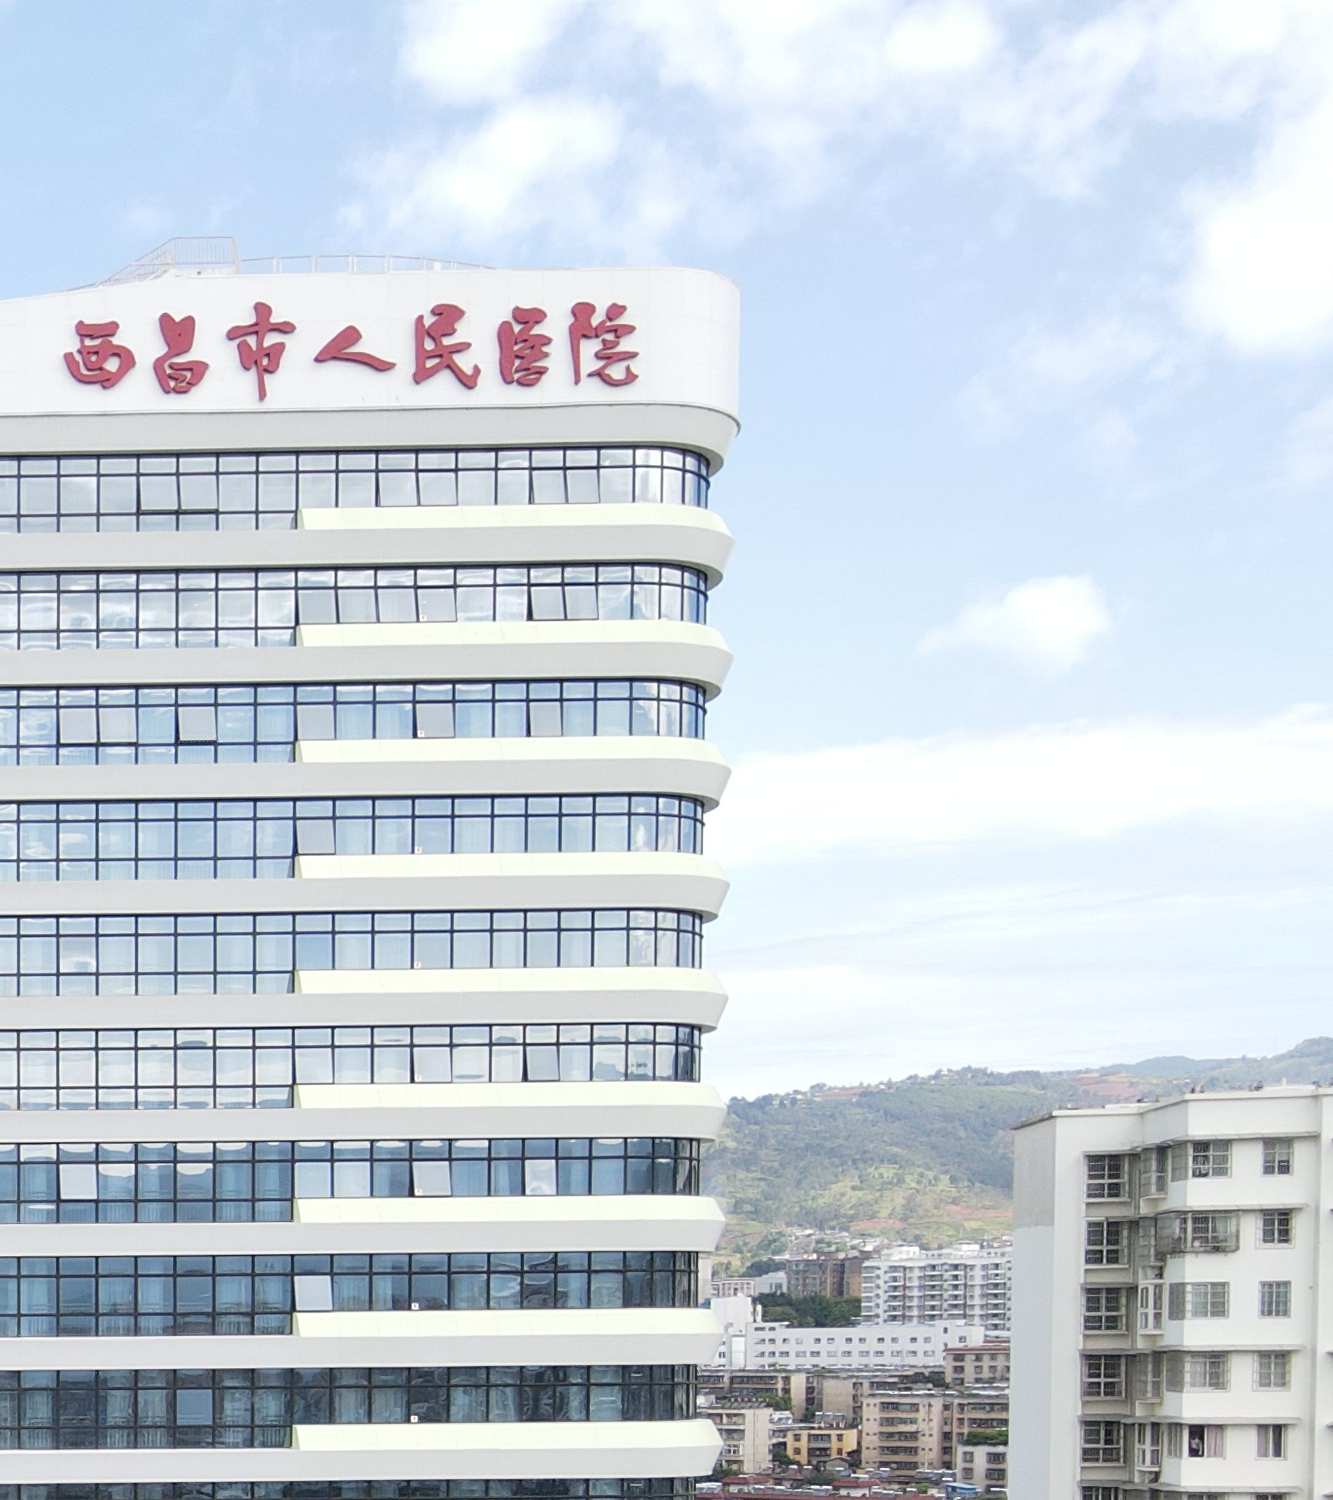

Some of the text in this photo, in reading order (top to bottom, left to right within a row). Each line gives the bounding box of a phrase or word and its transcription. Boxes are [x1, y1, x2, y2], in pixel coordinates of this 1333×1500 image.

[63, 301, 640, 401] 西昌市人民医院
